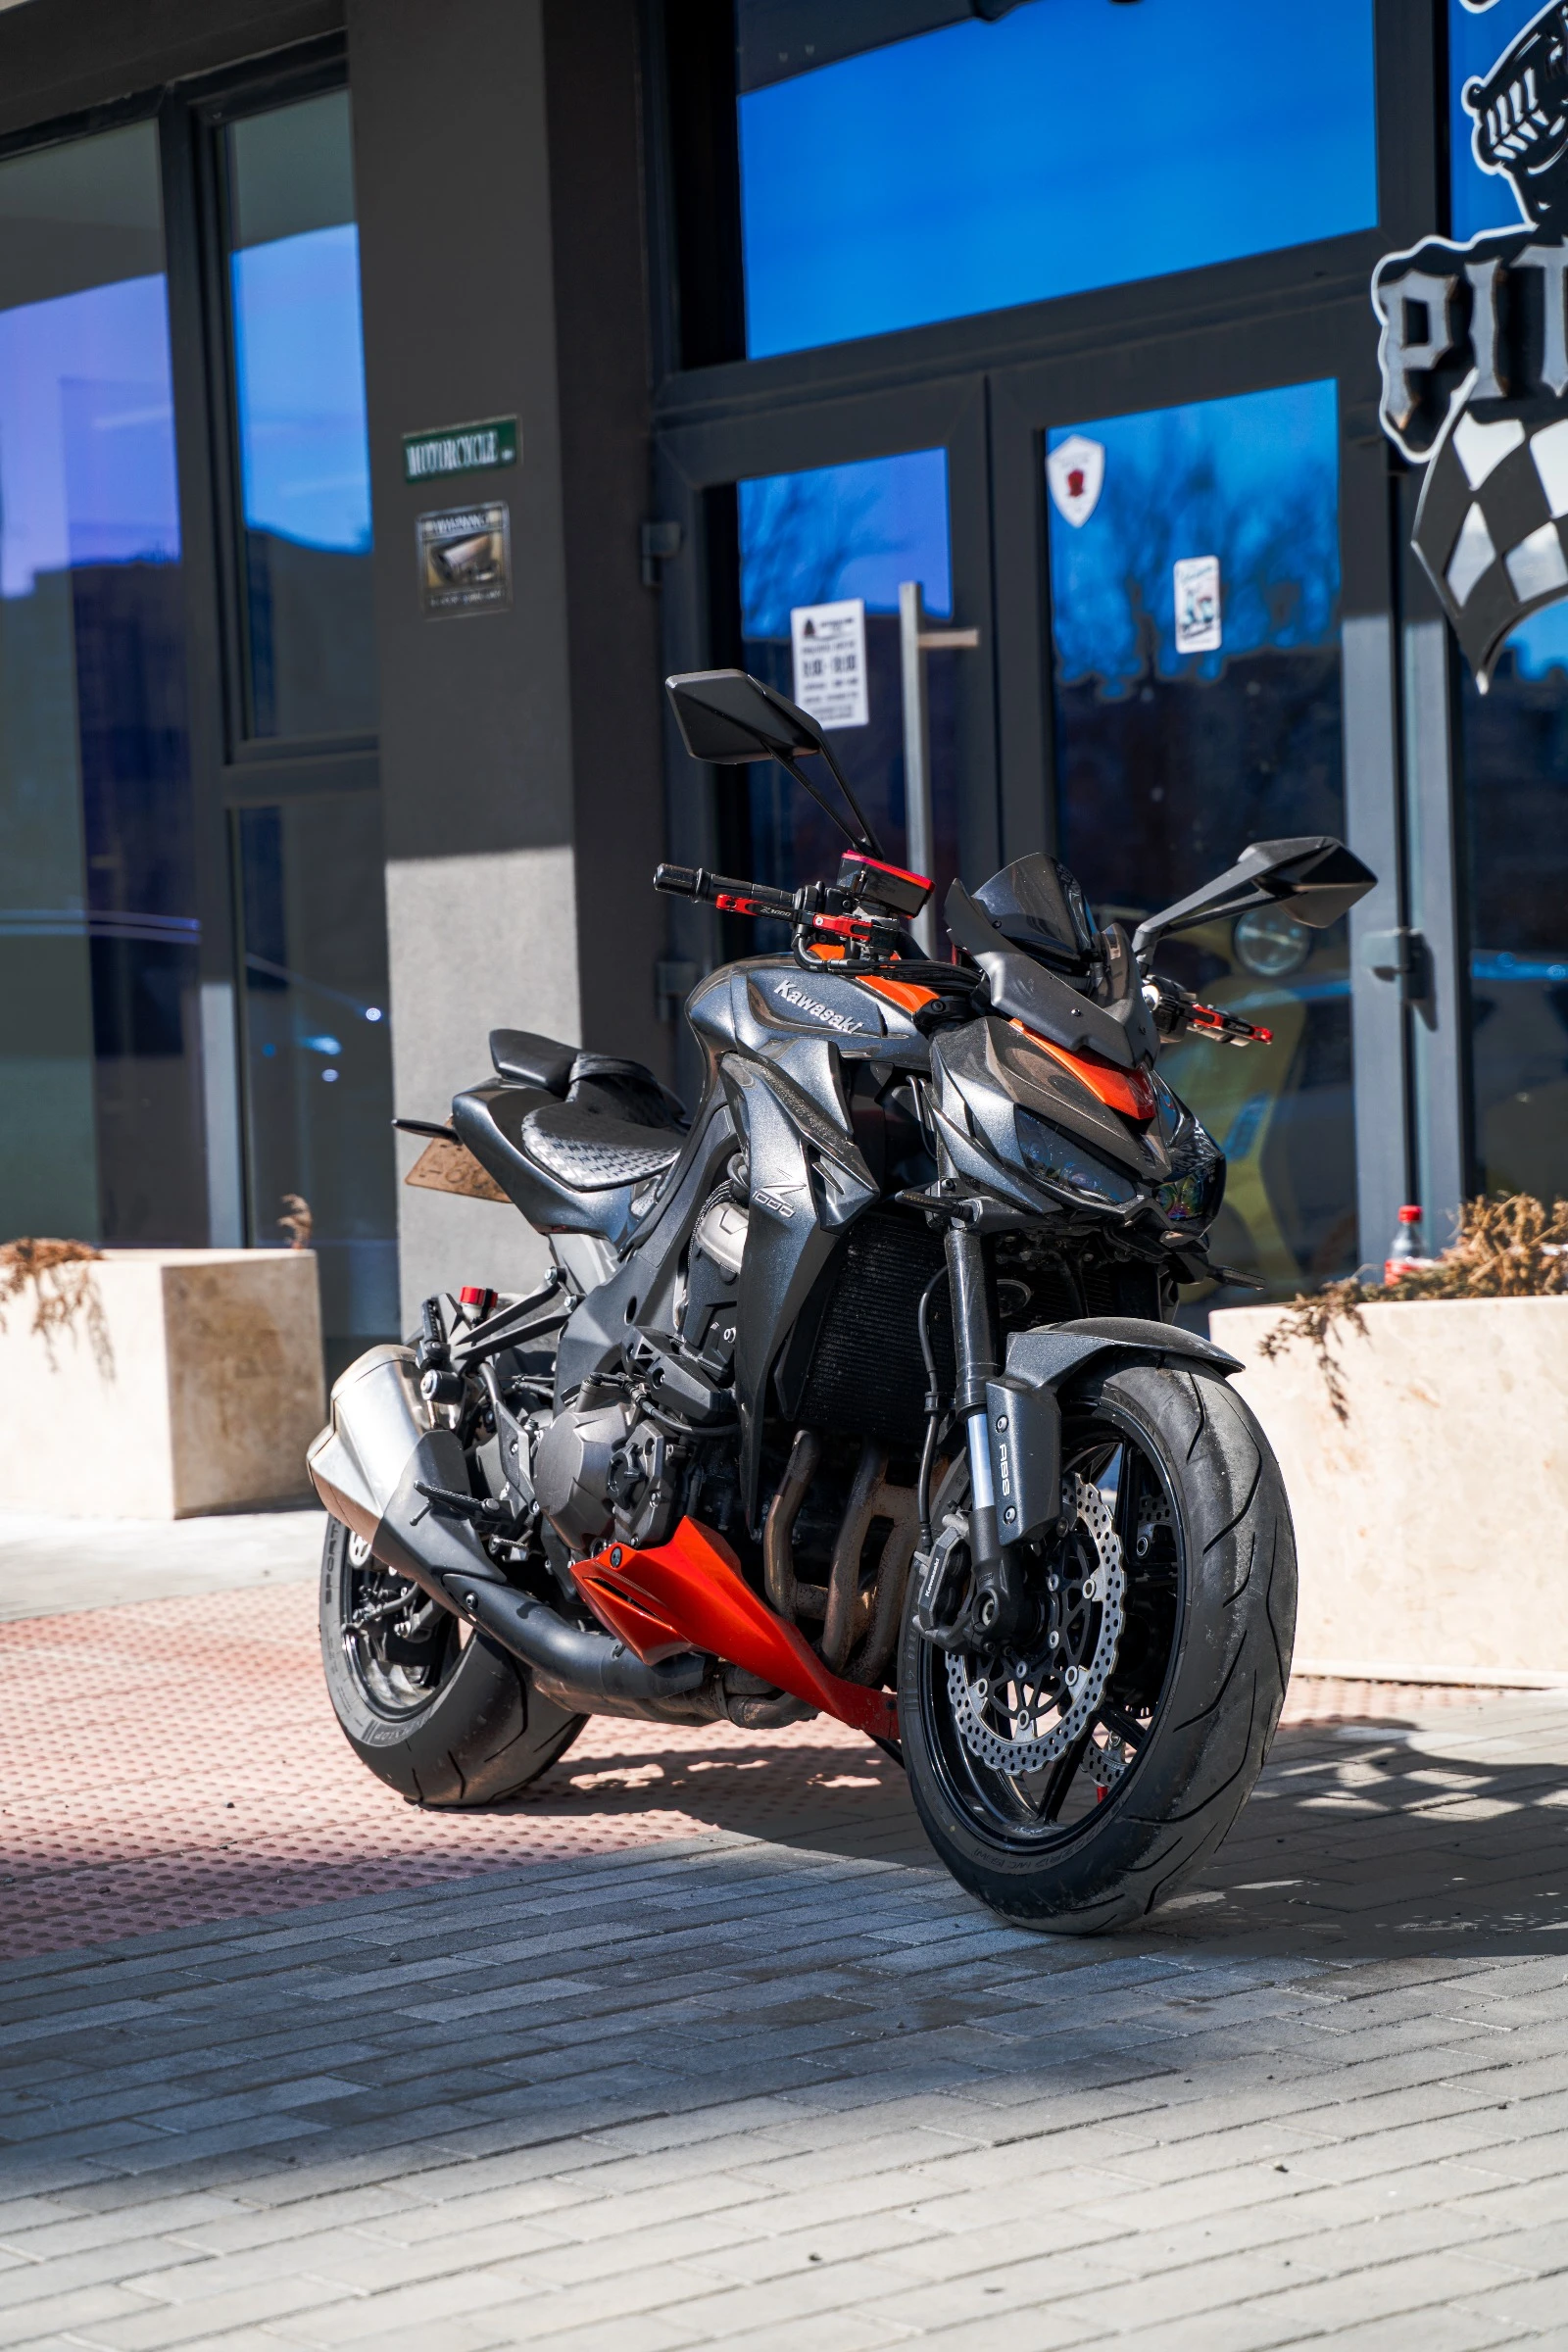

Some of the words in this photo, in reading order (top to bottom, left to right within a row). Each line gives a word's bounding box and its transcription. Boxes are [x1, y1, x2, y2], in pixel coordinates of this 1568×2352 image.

[1378, 236, 1568, 429] PIT
[406, 430, 499, 476] MOTORCYCLE
[773, 980, 863, 1034] Kawasaki
[999, 1444, 1010, 1496] ABS
